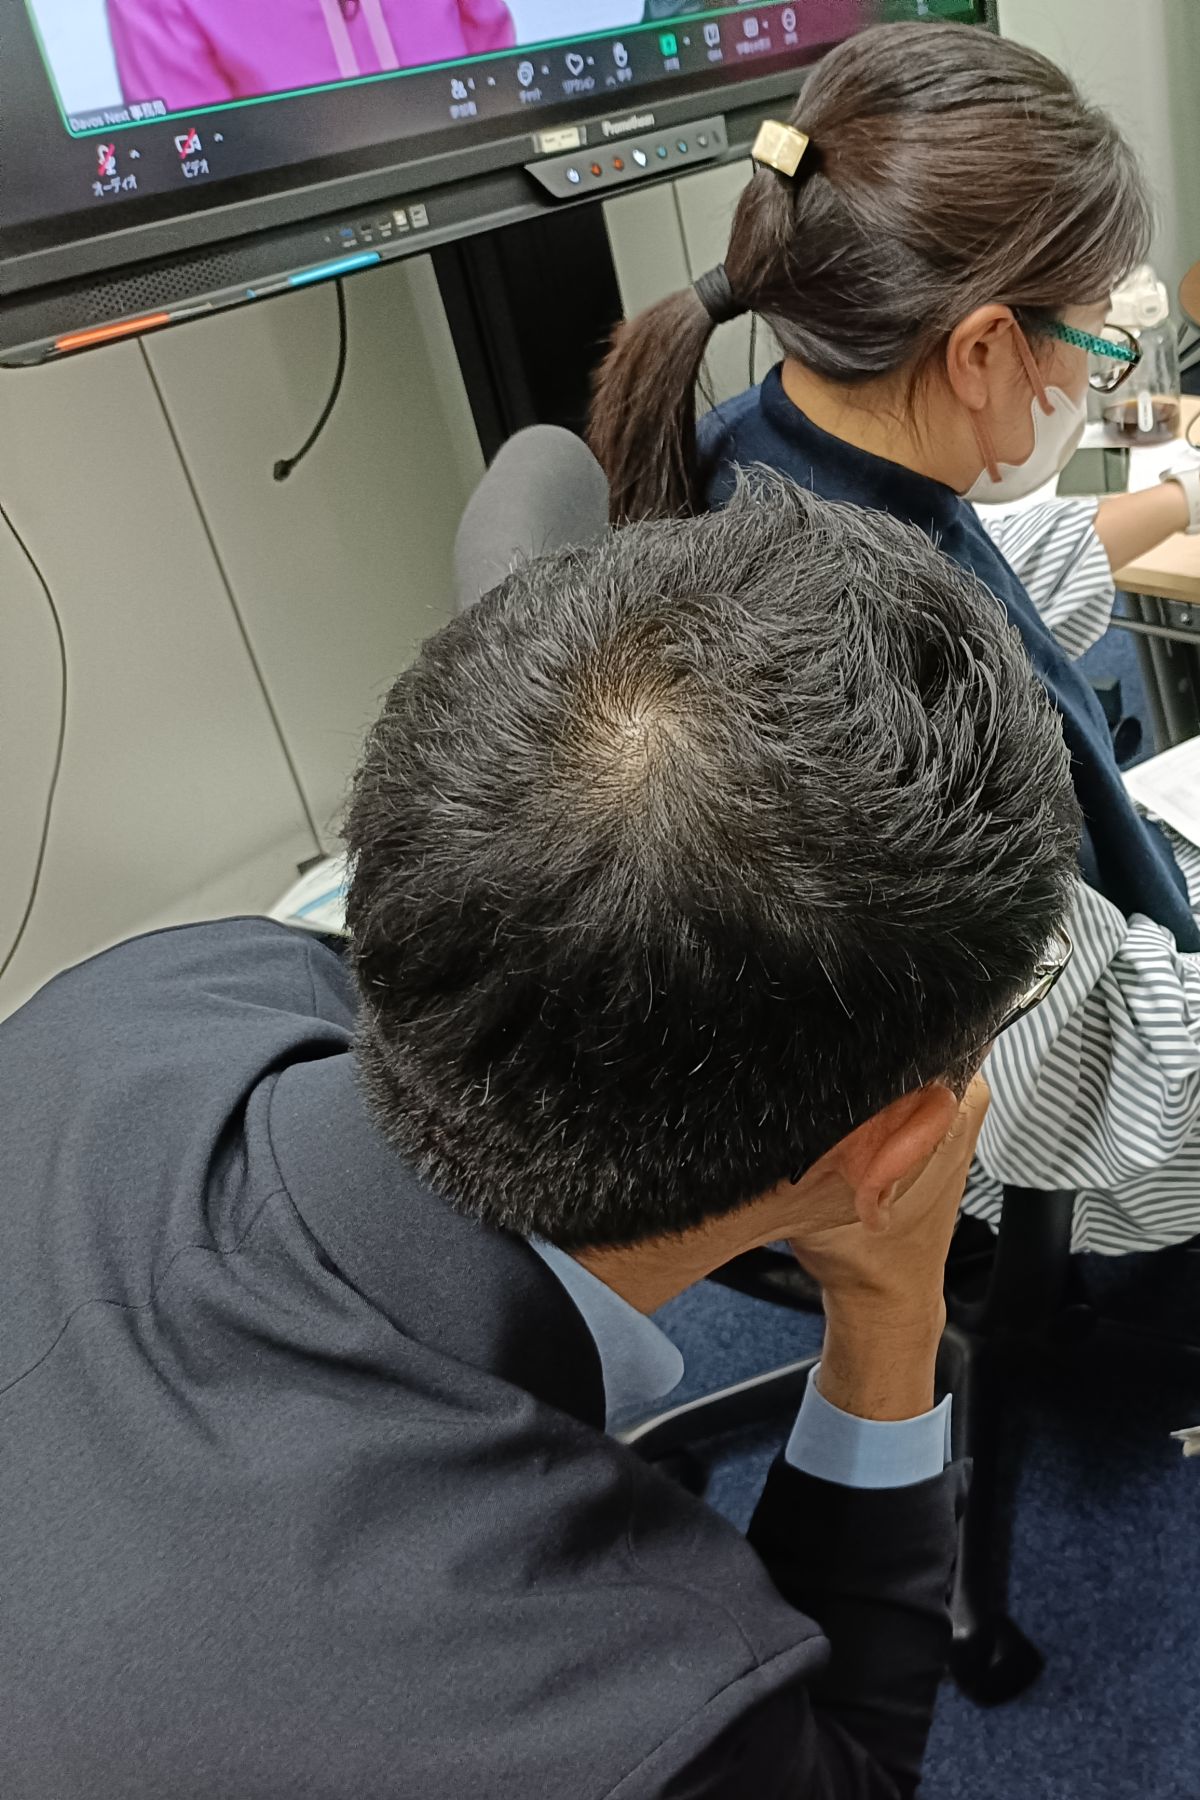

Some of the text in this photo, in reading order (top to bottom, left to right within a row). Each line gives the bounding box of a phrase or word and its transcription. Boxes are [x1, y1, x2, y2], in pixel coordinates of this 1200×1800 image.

[180, 158, 210, 178] ビデオ
[91, 174, 138, 197] オーディオ
